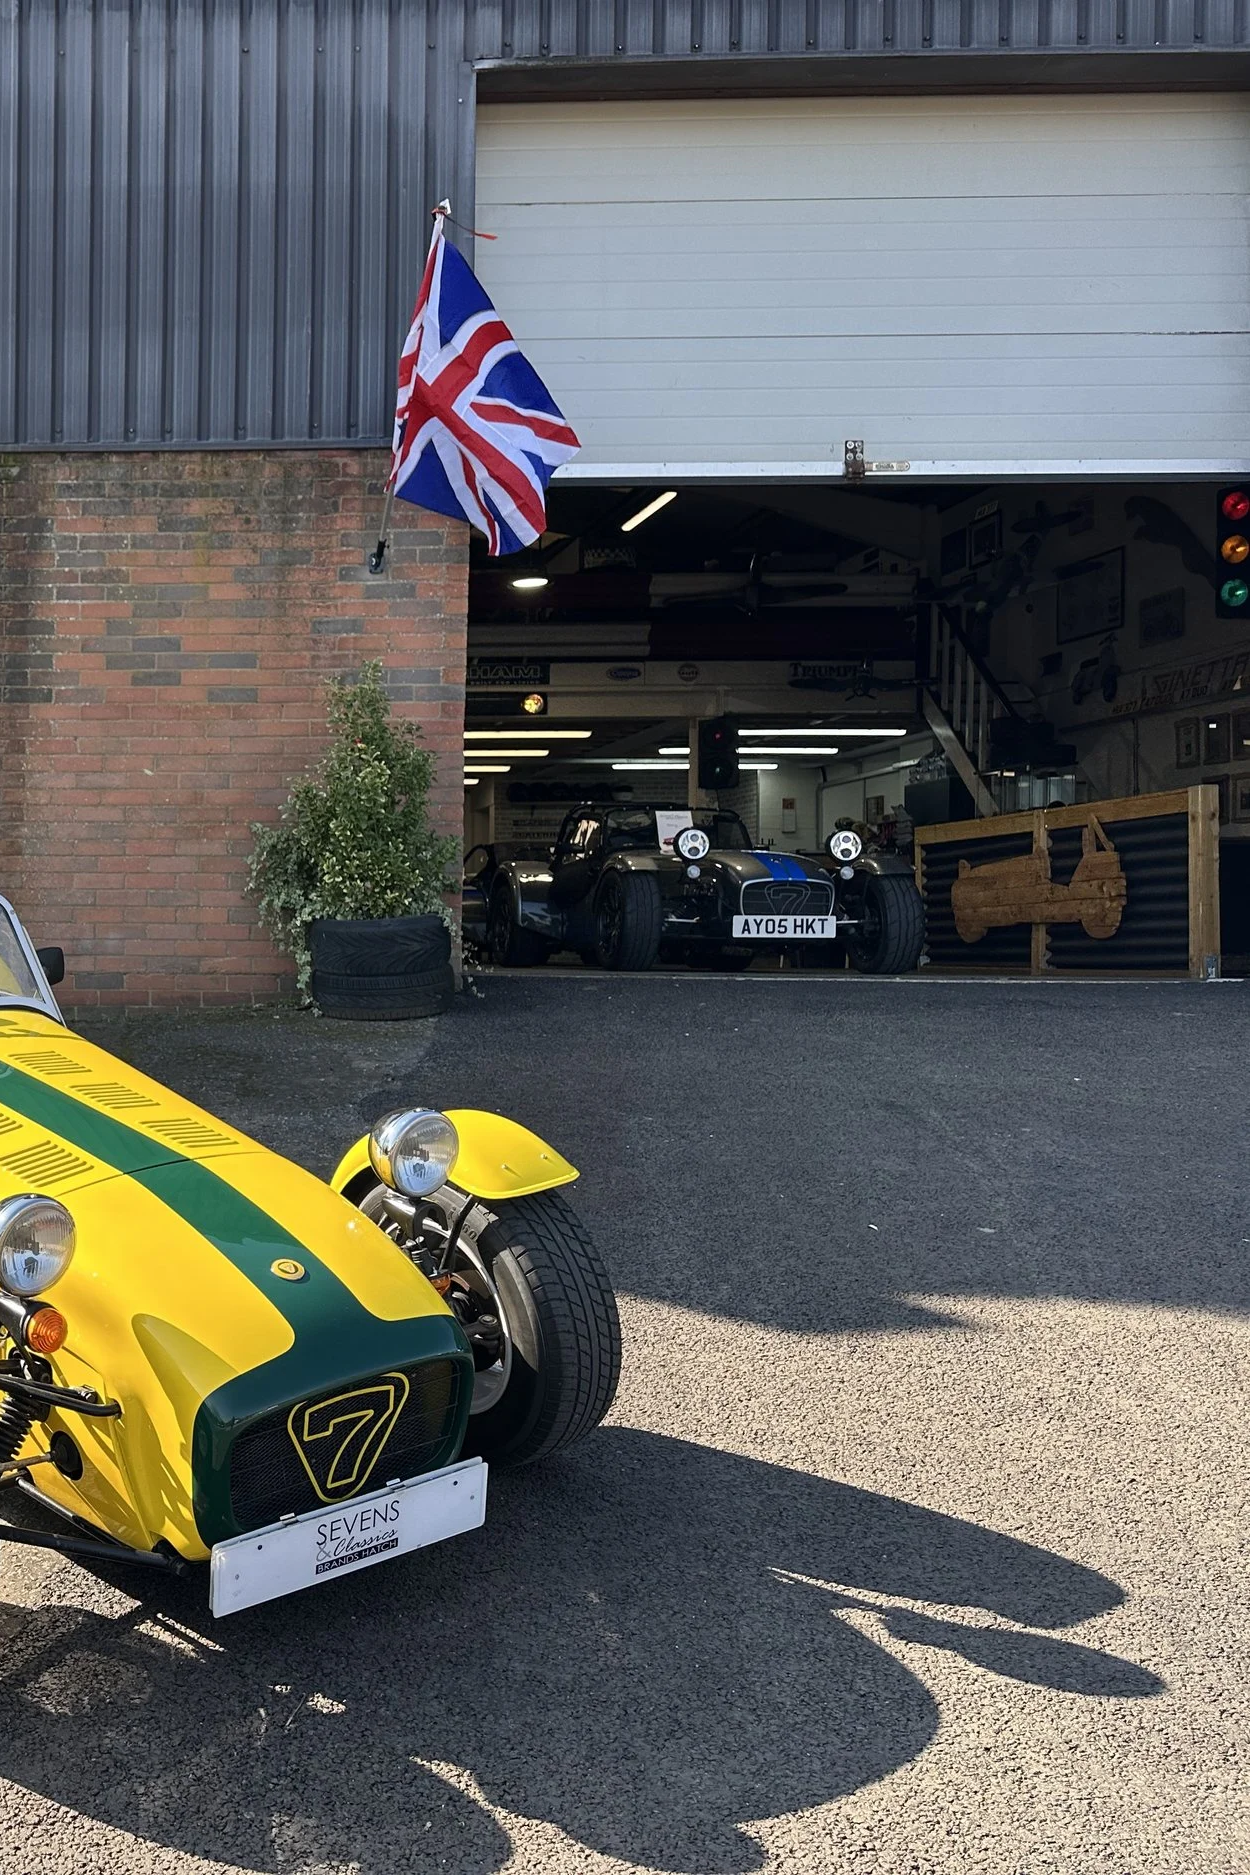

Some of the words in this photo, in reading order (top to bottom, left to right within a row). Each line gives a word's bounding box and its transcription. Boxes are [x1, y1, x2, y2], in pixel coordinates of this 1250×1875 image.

[741, 917, 788, 935] AY05
[793, 917, 829, 935] HKT
[316, 1499, 400, 1546] SEVENS
[317, 1552, 360, 1573] BRANDS
[361, 1539, 397, 1558] HATCH
[333, 1529, 398, 1557] Classics
